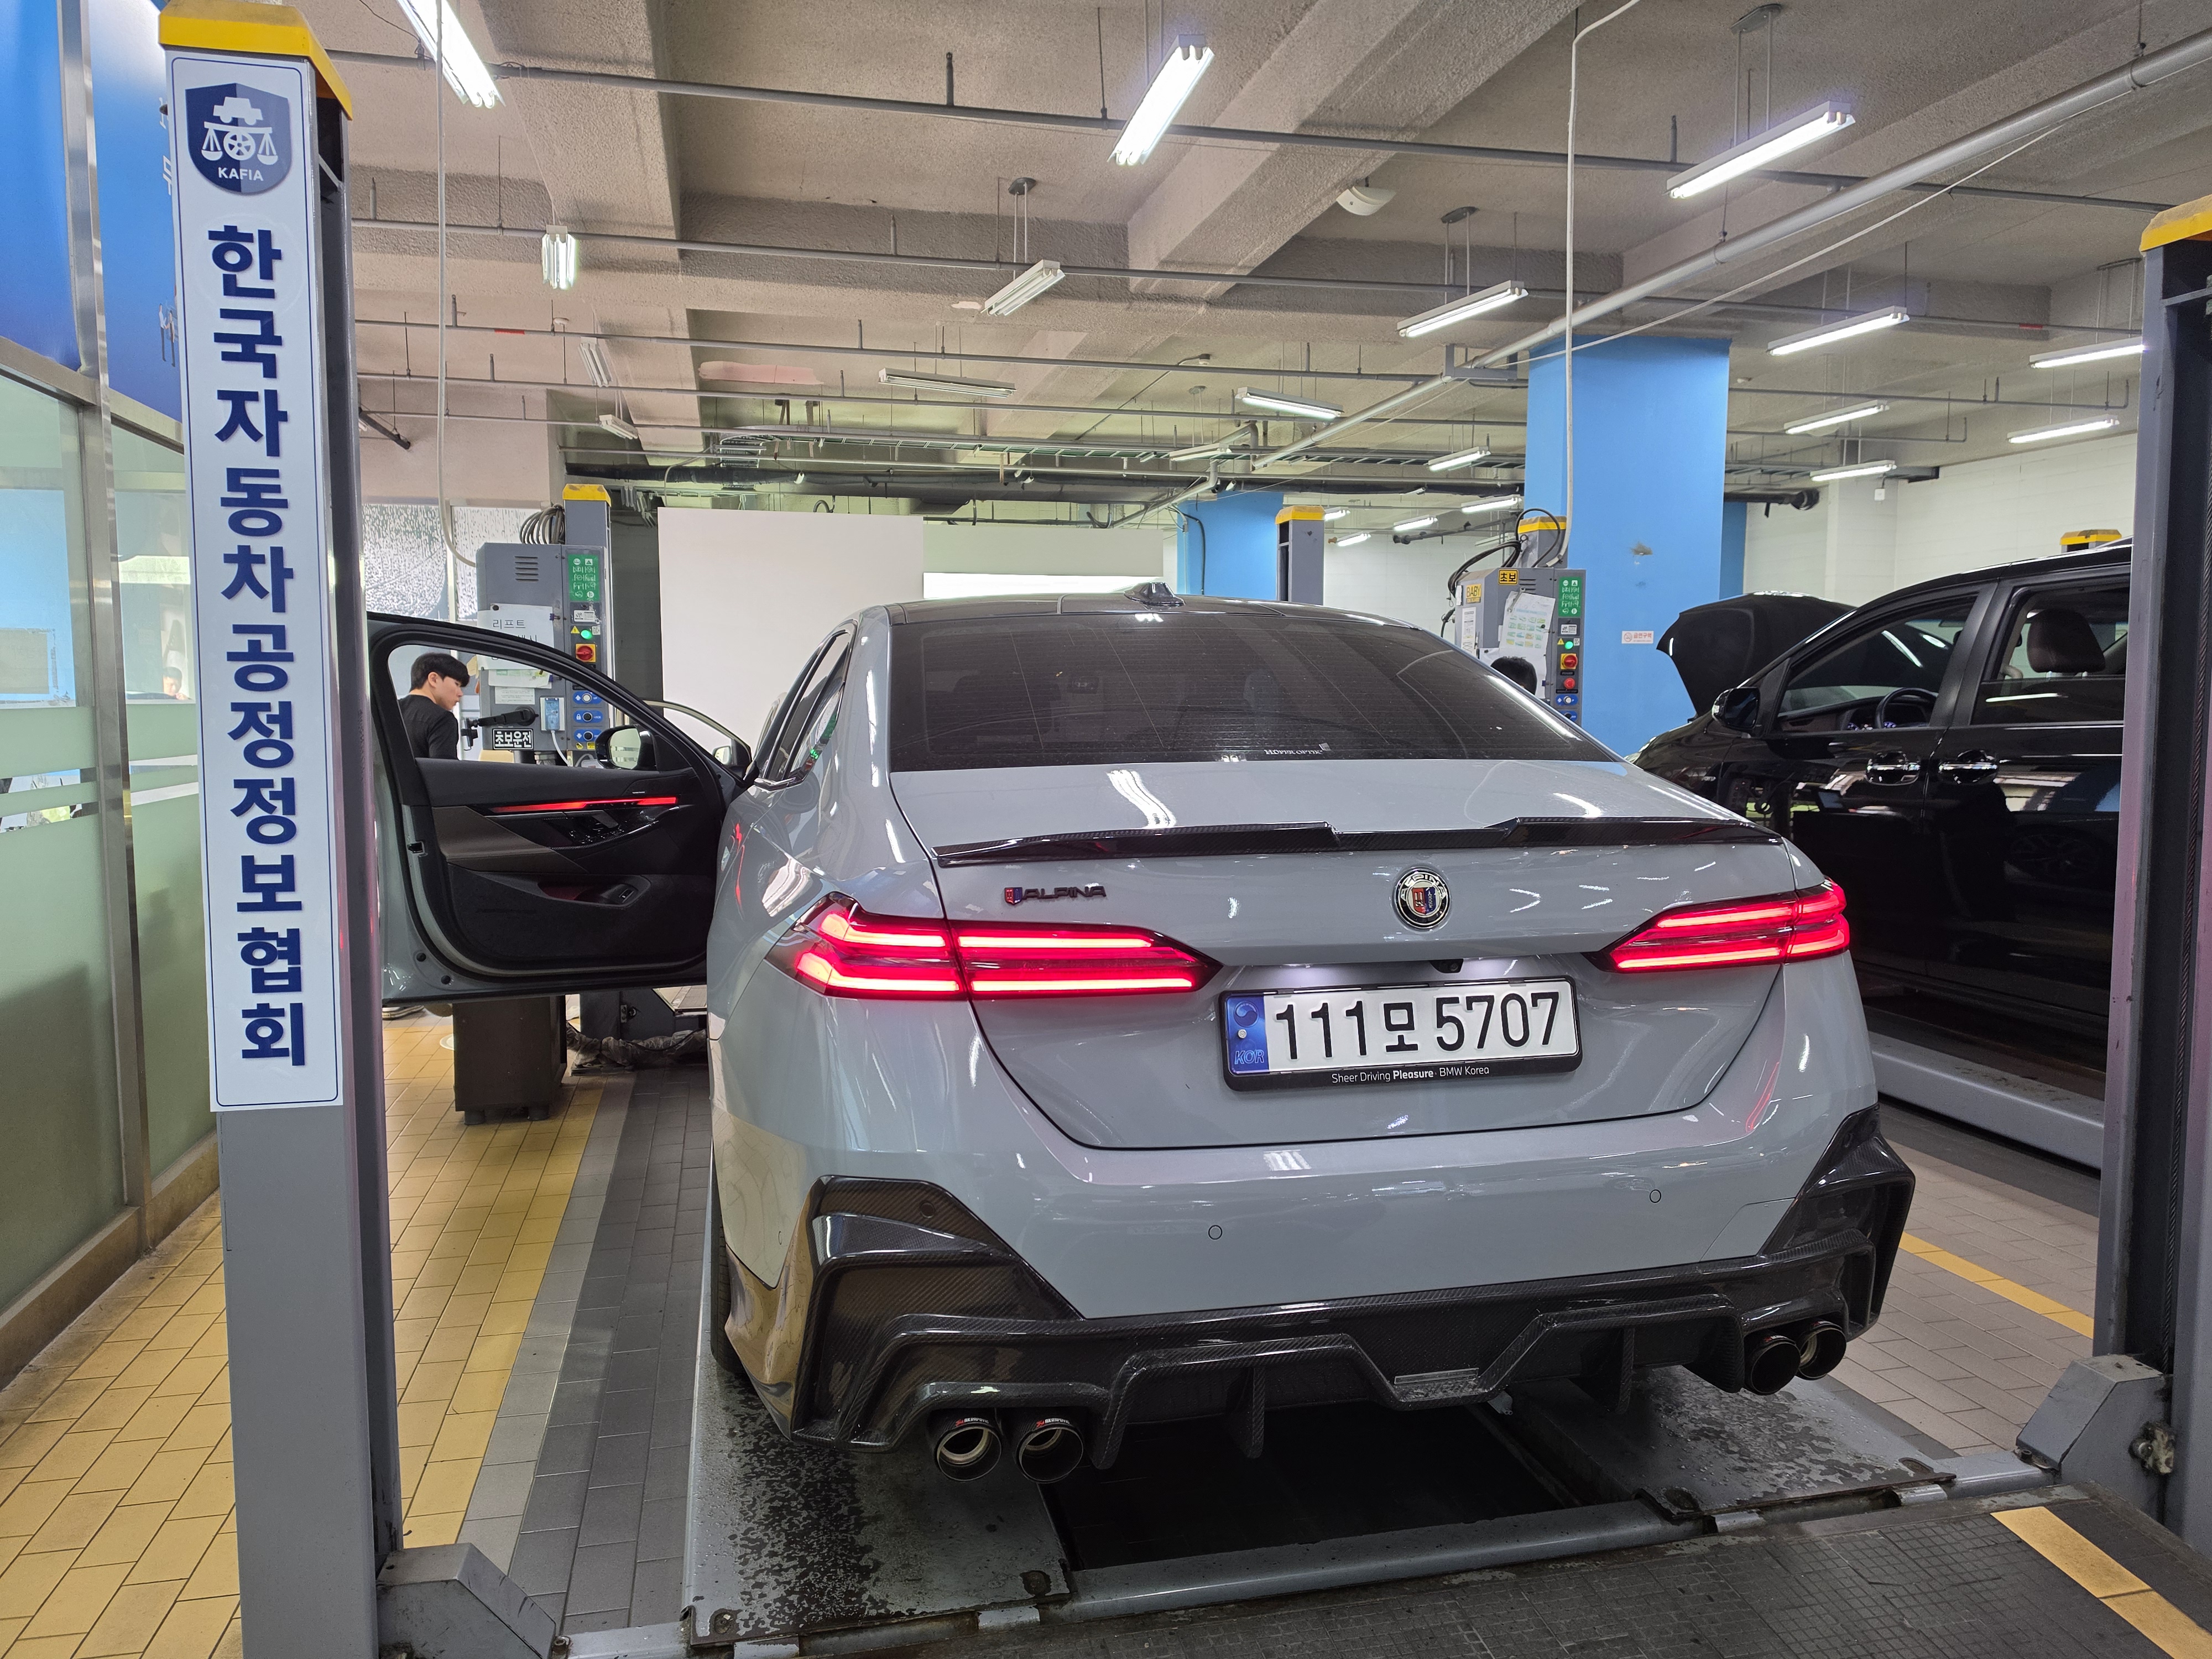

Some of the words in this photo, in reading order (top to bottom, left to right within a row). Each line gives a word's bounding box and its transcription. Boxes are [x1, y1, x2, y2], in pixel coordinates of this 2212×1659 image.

[218, 167, 264, 181] KAFIA
[1500, 572, 1516, 582] 초보
[1466, 586, 1481, 597] BABY
[493, 619, 526, 629] 리프트
[207, 225, 306, 1066] 한국자동차공정정보협회
[494, 731, 531, 748] 초보운전
[1023, 886, 1107, 900] ALPINA
[1400, 873, 1447, 901] ALPINA
[1276, 1001, 1418, 1060] 111모
[1436, 992, 1560, 1051] 5707
[1234, 1049, 1265, 1065] KOR
[1332, 1073, 1358, 1083] Sheer
[1360, 1071, 1391, 1082] Driving
[1393, 1070, 1433, 1079] Pleasure
[1439, 1066, 1463, 1077] BMW
[1465, 1066, 1489, 1075] Korea
